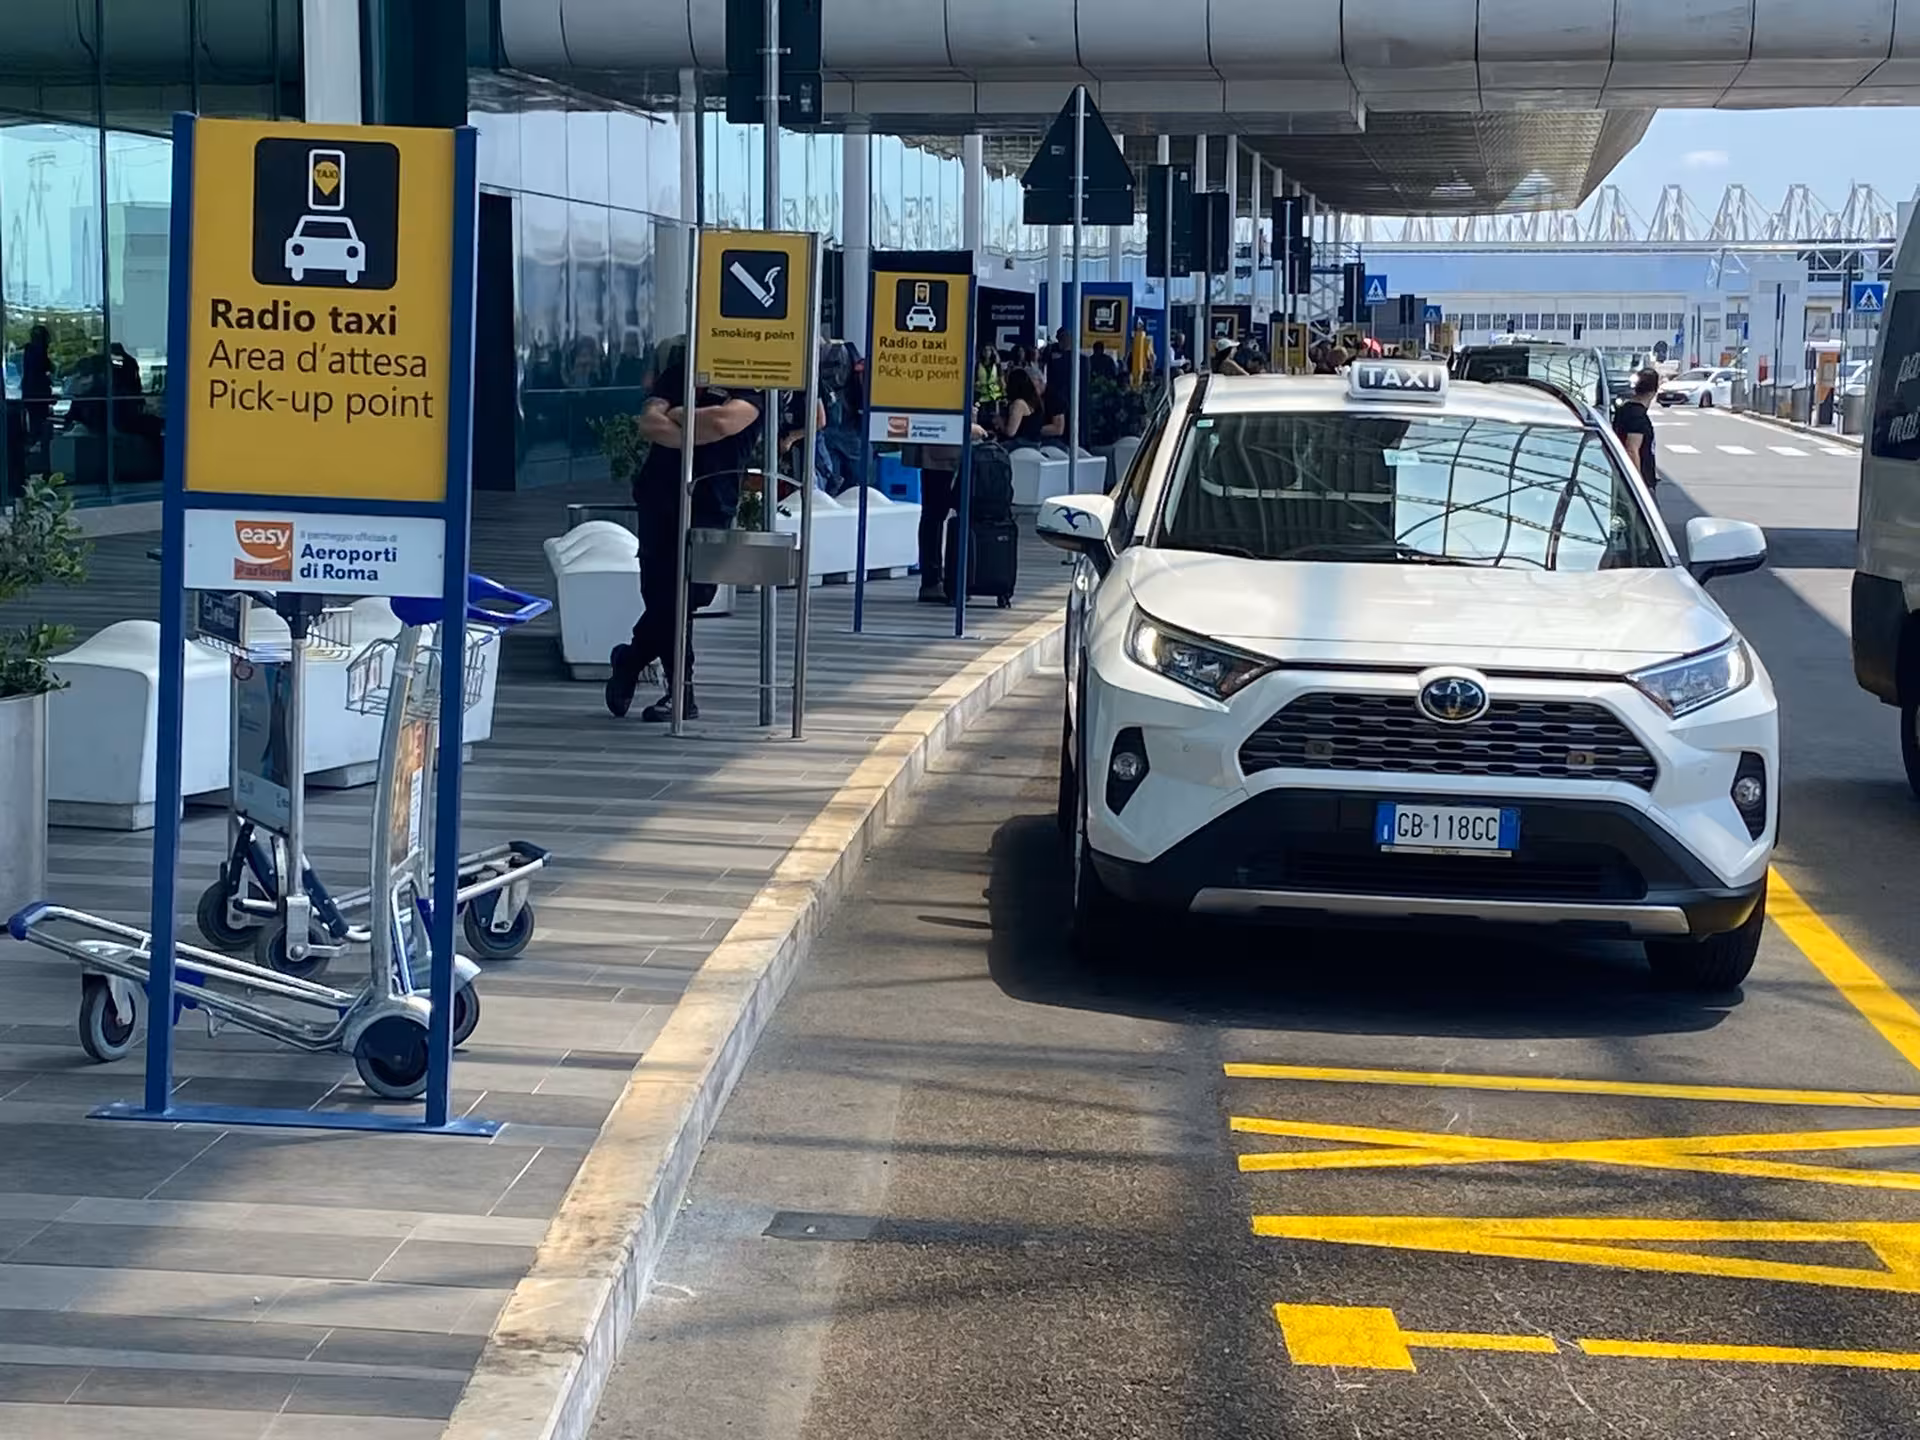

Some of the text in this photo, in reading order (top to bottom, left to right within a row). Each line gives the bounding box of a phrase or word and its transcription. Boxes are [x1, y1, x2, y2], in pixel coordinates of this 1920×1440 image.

[315, 168, 338, 179] TAXI
[210, 298, 397, 336] Radio taxi
[711, 327, 795, 342] Smoking point
[879, 336, 947, 351] Radio taxi
[208, 339, 427, 378] Area d'attesa
[878, 351, 907, 364] Area
[878, 365, 960, 382] Pick-up point
[1361, 366, 1435, 389] TAXI
[209, 379, 434, 424] Pick-up point
[239, 527, 291, 550] easy
[300, 543, 398, 565] Aeroporti
[300, 562, 378, 581] di Roma
